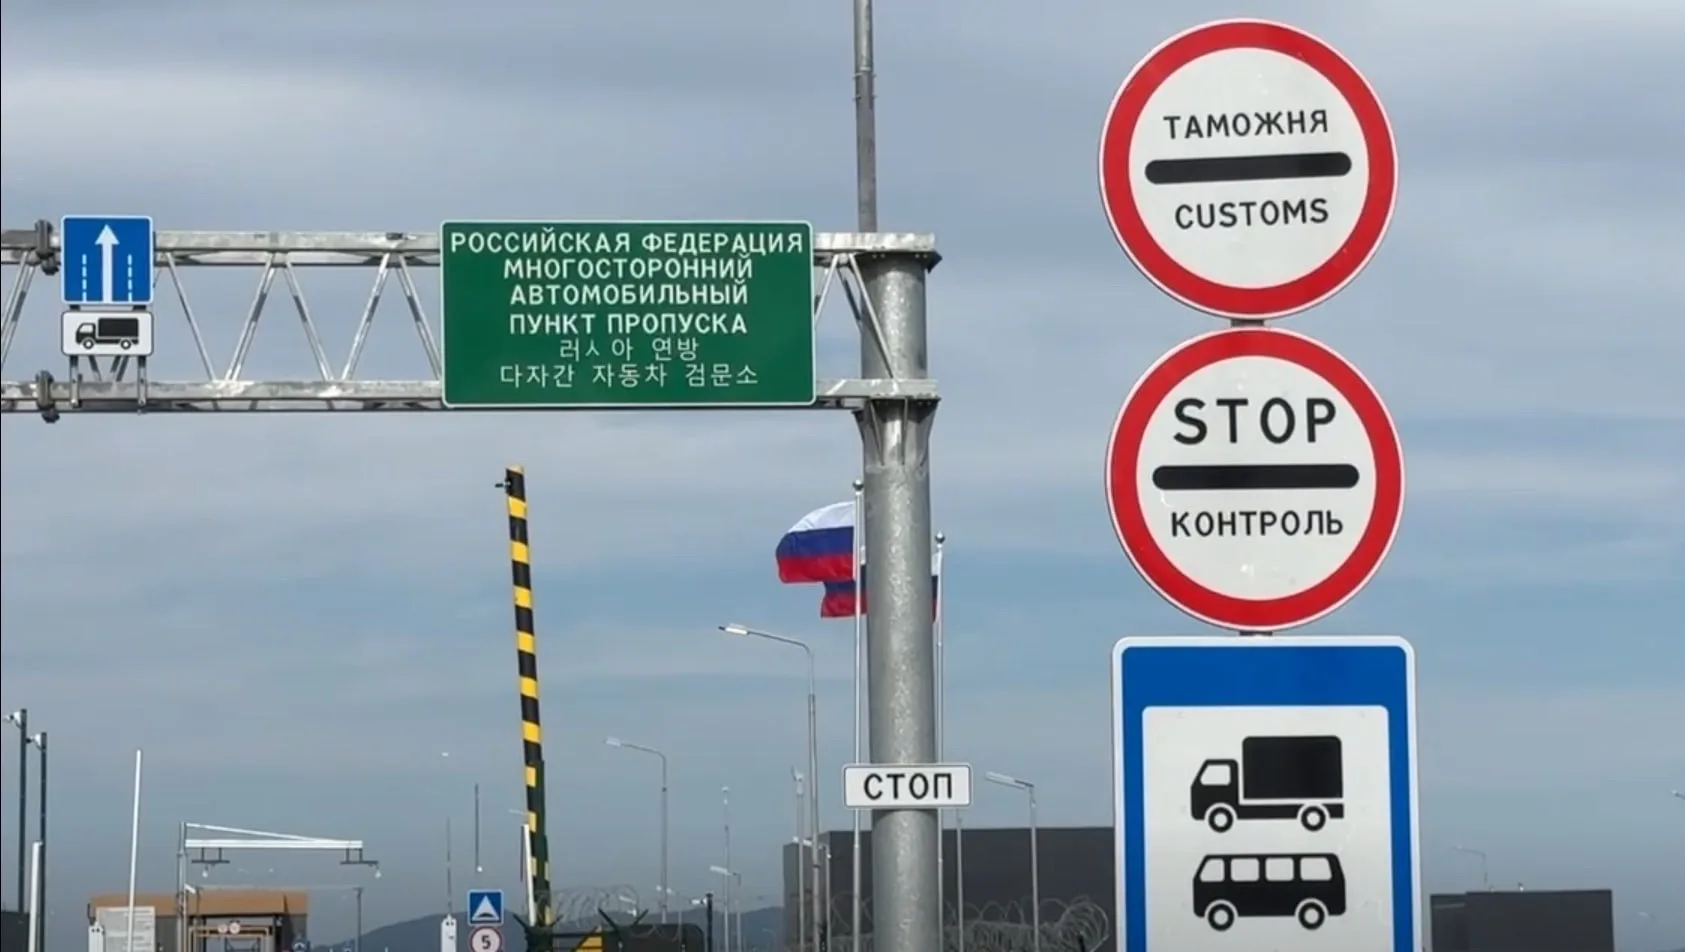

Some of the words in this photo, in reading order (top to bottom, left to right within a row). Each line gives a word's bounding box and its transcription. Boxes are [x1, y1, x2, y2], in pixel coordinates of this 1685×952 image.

[1163, 109, 1328, 140] ТАМОЖНЯ
[1175, 198, 1329, 230] CUSTOMS
[451, 227, 630, 253] РОССИЙСКАЯ
[642, 232, 803, 256] ФЕДЕРАЦИЯ
[504, 254, 752, 279] МНОГОСТОРОННИЙ
[510, 279, 748, 305] АВТОМОБИЛЬНЫЙ
[510, 314, 596, 334] ПУНКТ
[607, 313, 747, 334] ПРОПУСКА
[651, 337, 699, 361] 연방
[500, 363, 575, 388] 다자간
[592, 363, 667, 388] 자동차
[685, 363, 759, 388] 검문소
[1173, 397, 1336, 445] STOP
[1171, 510, 1344, 537] КОНТРОЛЬ
[863, 773, 952, 800] СТОП
[481, 934, 491, 950] 5
